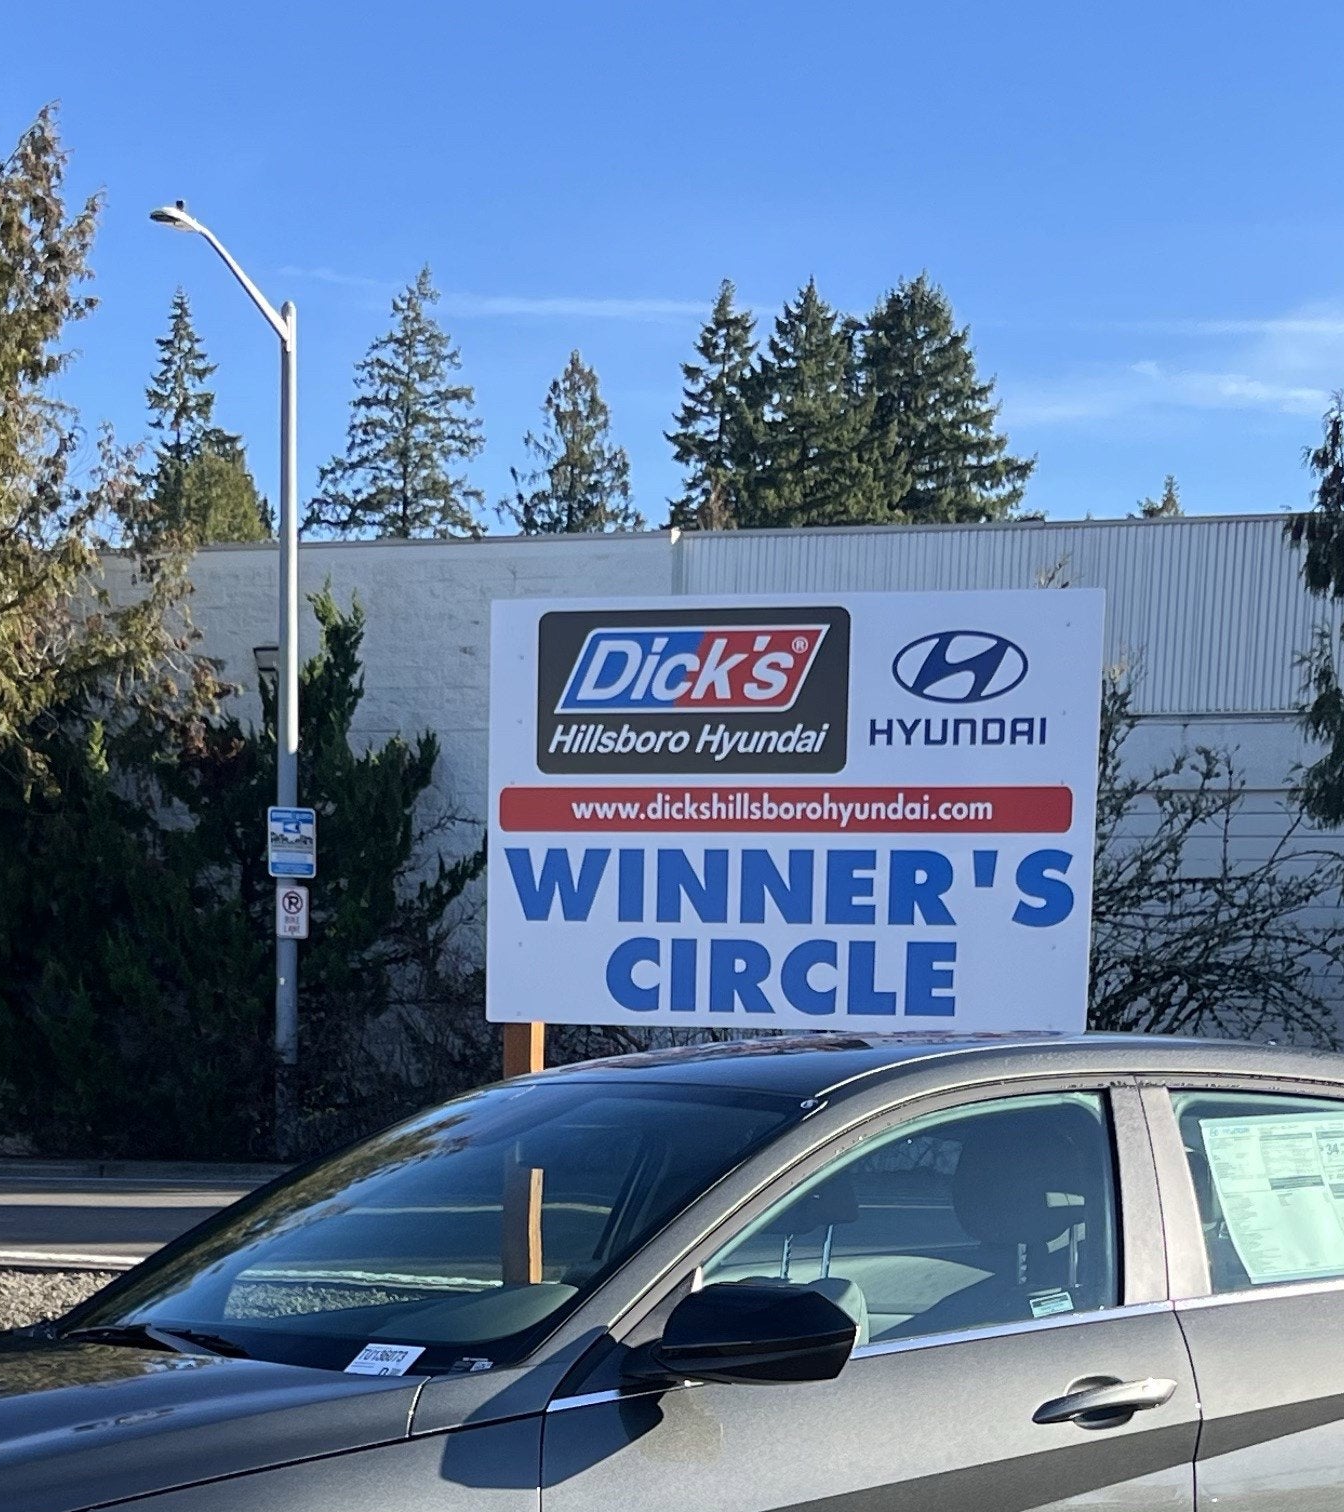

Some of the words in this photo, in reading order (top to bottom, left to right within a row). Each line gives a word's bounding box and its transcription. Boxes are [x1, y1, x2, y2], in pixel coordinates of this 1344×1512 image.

[577, 635, 794, 702] Dick's
[548, 724, 690, 754] Hillsboro
[695, 724, 830, 760] Hyundai
[869, 717, 1047, 746] HYUNDAI
[571, 794, 994, 828] www.dickshillsborohyundai.com
[505, 847, 1075, 927] WINNER'S
[605, 936, 957, 1016] CIRCLE
